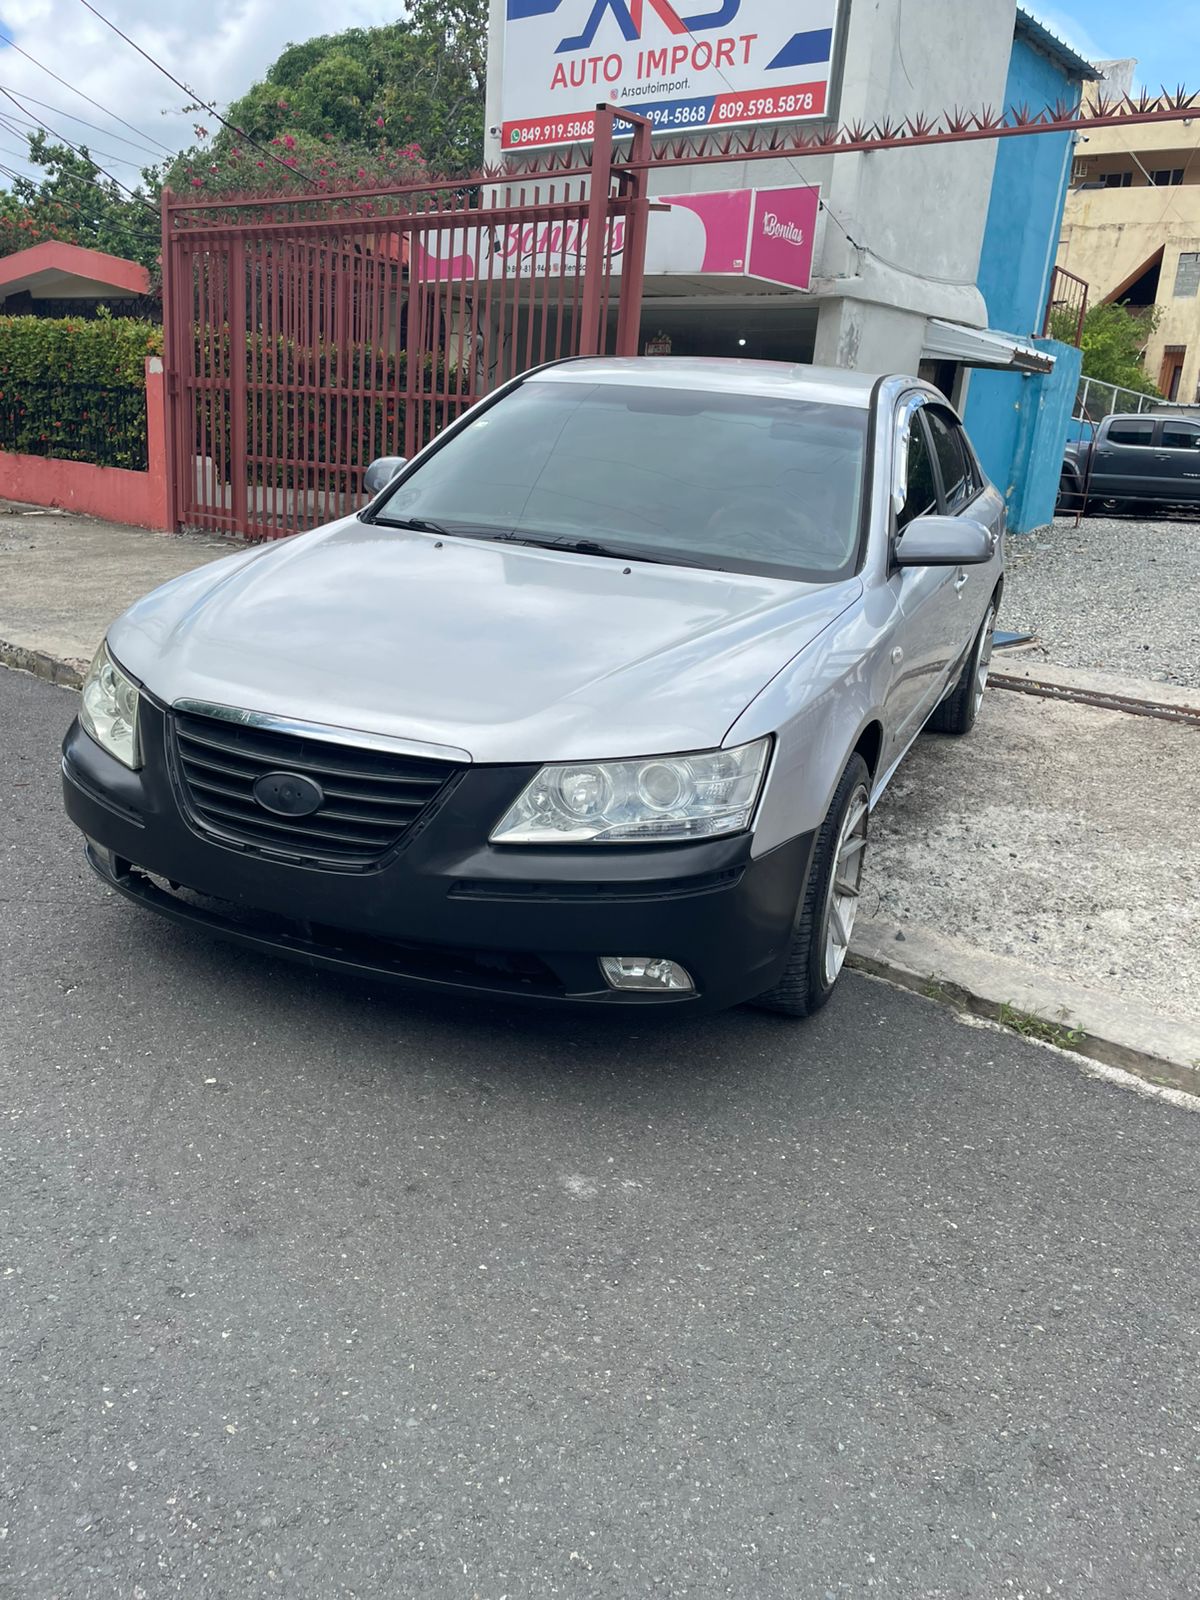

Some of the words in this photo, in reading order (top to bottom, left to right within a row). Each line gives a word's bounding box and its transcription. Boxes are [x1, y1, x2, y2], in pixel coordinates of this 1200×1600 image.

[550, 54, 623, 90] AUTO
[636, 34, 758, 80] IMPORT
[521, 120, 595, 142] 849.919.5868
[718, 92, 813, 119] 809.598.5878
[497, 217, 625, 257] Bonits
[767, 213, 803, 243] Bonitas
